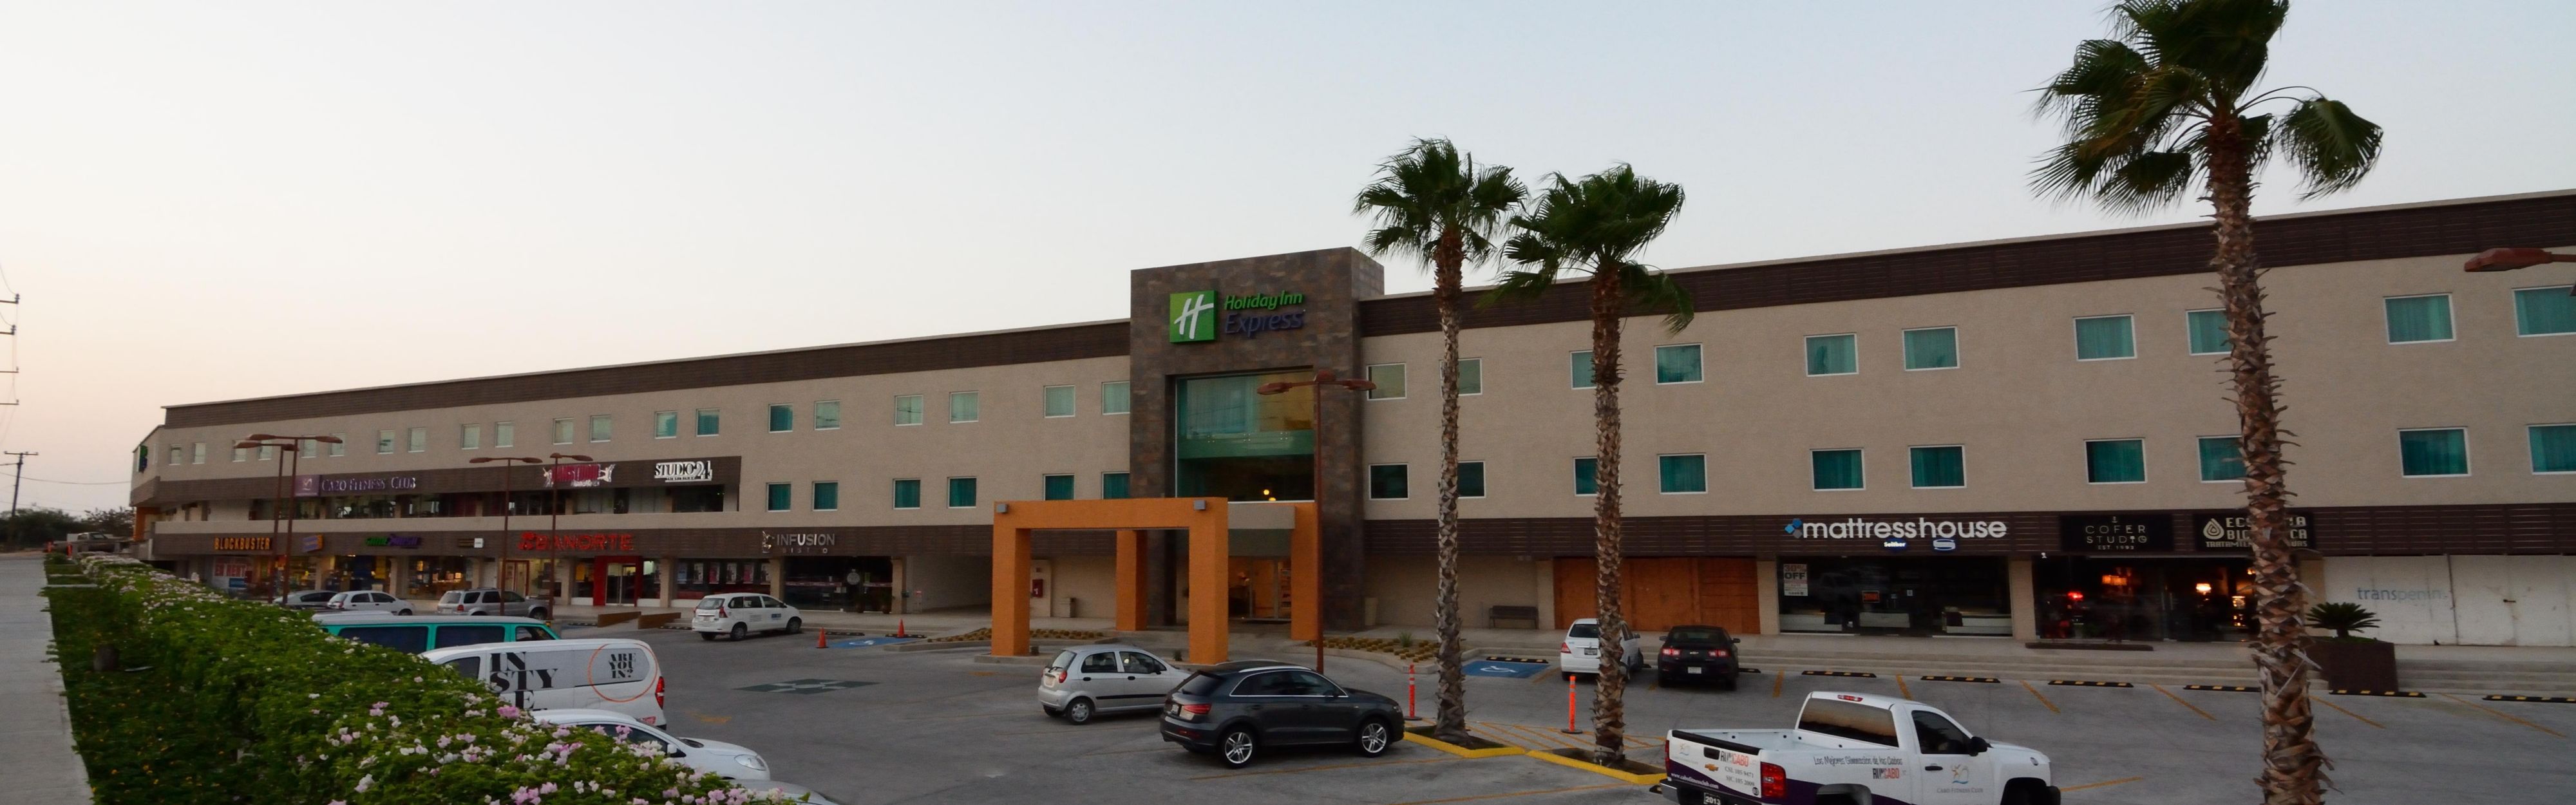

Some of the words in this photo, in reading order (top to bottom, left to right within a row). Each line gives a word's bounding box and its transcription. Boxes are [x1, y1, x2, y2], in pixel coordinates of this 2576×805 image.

[1224, 294, 1278, 310] Holiday
[1280, 290, 1303, 305] Inn
[1226, 312, 1303, 337] Express
[654, 464, 694, 477] STUDIO
[1803, 517, 2007, 539] mattresshouse
[2085, 525, 2146, 534] COFER
[214, 537, 270, 550] BLOCKBUSTER
[536, 534, 634, 551] BANORTE
[777, 534, 835, 545] INFUSION
[1785, 564, 1807, 573] 30%
[491, 652, 527, 672] IN
[610, 653, 636, 661] ARE
[609, 660, 634, 669] YOU
[612, 669, 633, 678] IN?
[490, 668, 558, 694] STY
[1705, 796, 1721, 805] 2013
